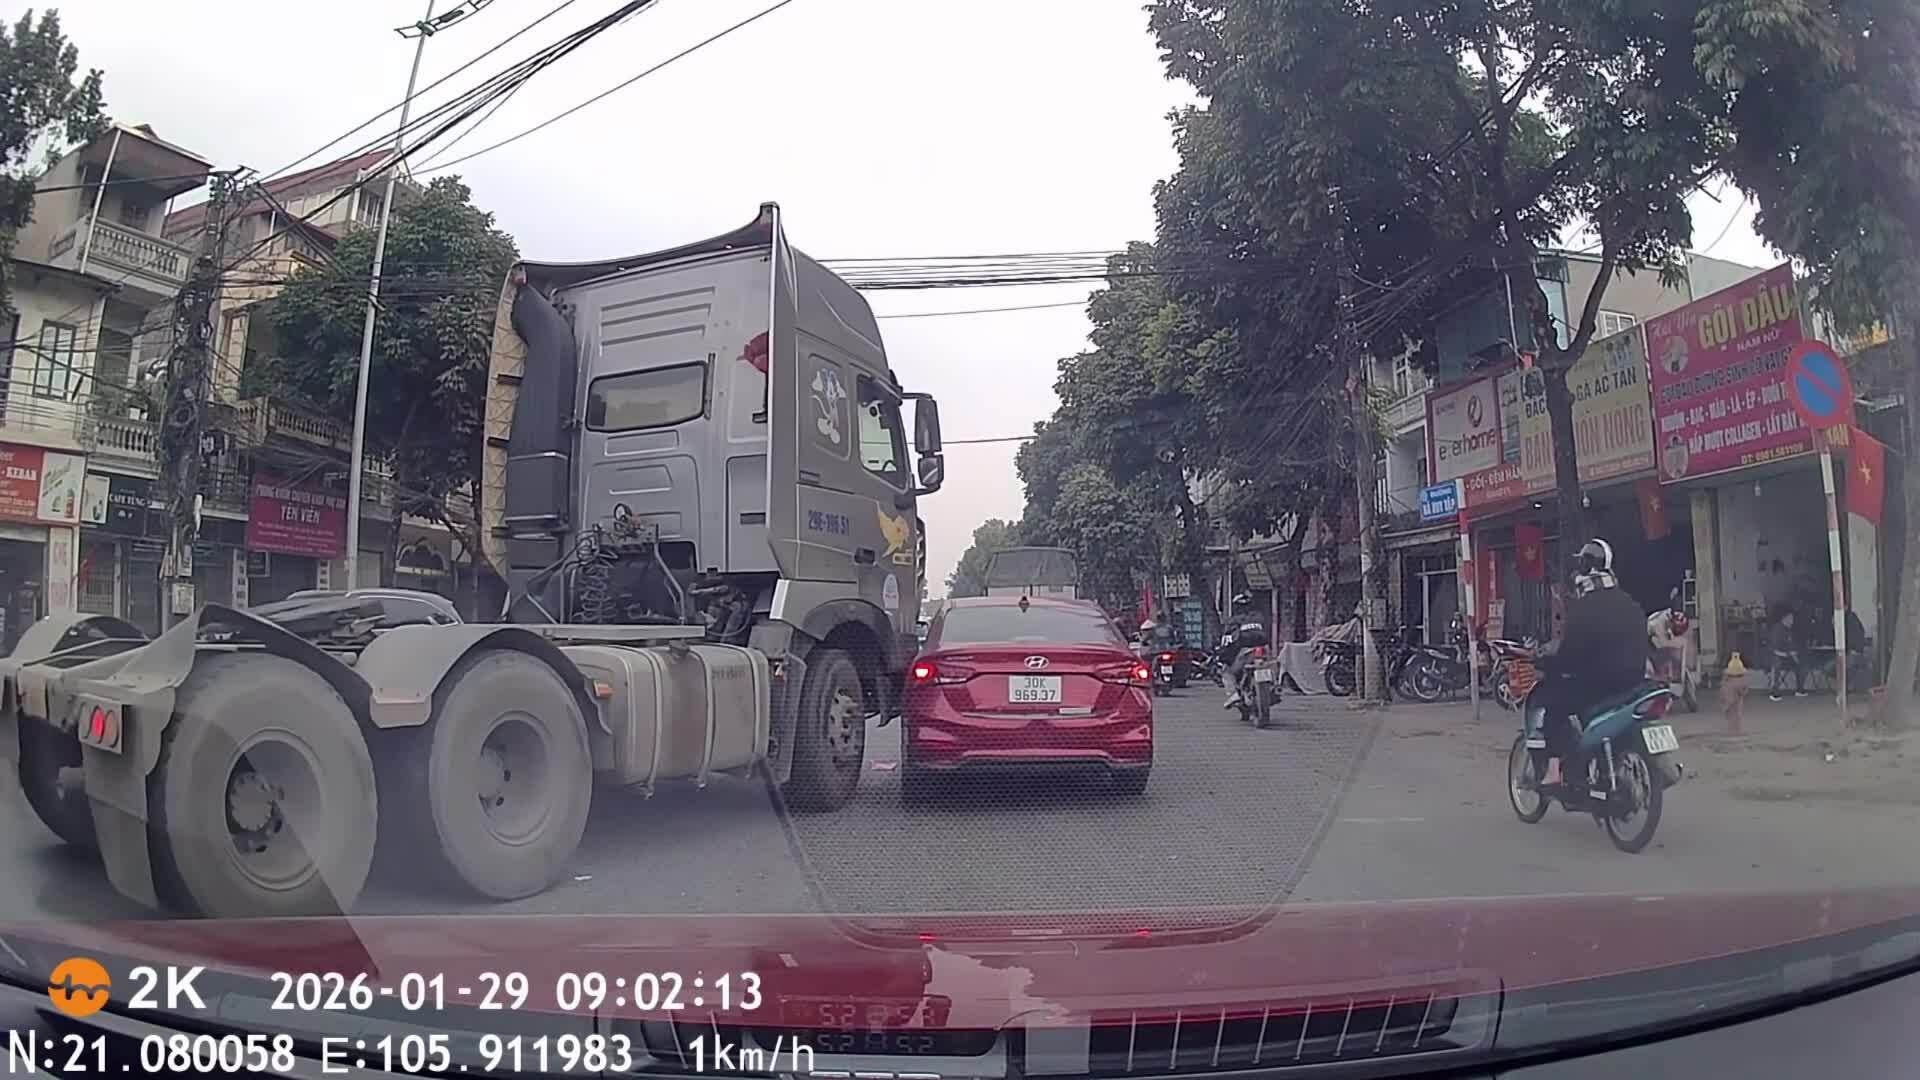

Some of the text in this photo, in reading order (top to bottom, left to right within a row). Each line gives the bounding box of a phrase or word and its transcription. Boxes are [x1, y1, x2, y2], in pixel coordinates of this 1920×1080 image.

[1699, 278, 1792, 351] GỘI ĐẦU
[1737, 335, 1761, 352] NAM
[1725, 420, 1761, 446] COLLAGEN
[1024, 677, 1046, 689] 30K
[1015, 689, 1056, 701] 969.37
